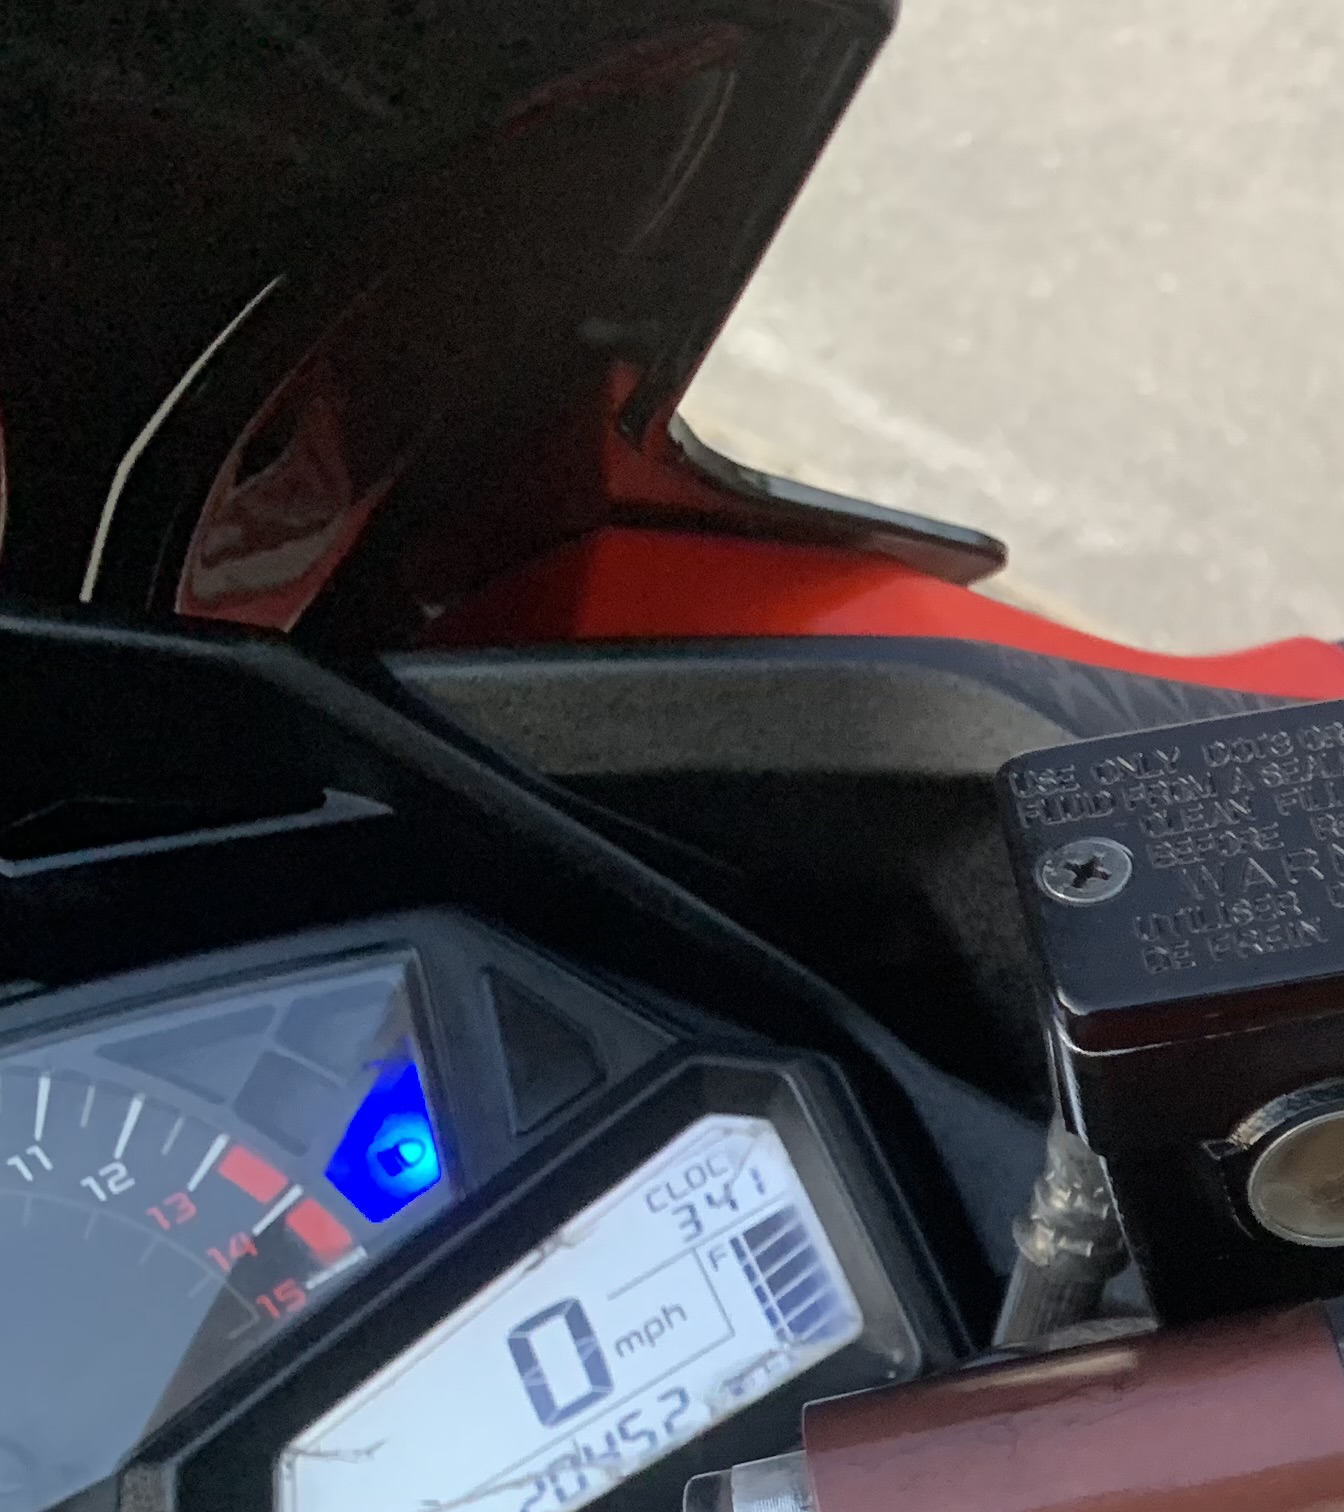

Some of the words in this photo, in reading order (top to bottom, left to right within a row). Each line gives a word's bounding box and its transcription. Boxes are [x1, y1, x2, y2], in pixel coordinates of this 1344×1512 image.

[7, 1144, 53, 1182] 11
[80, 1161, 136, 1202] 12
[646, 1150, 744, 1214] CLOC
[146, 1192, 197, 1231] 13
[206, 1231, 258, 1273] 14
[706, 1242, 729, 1273] F
[256, 1278, 308, 1320] 15
[507, 1297, 613, 1428] 0
[614, 1302, 688, 1358] mph
